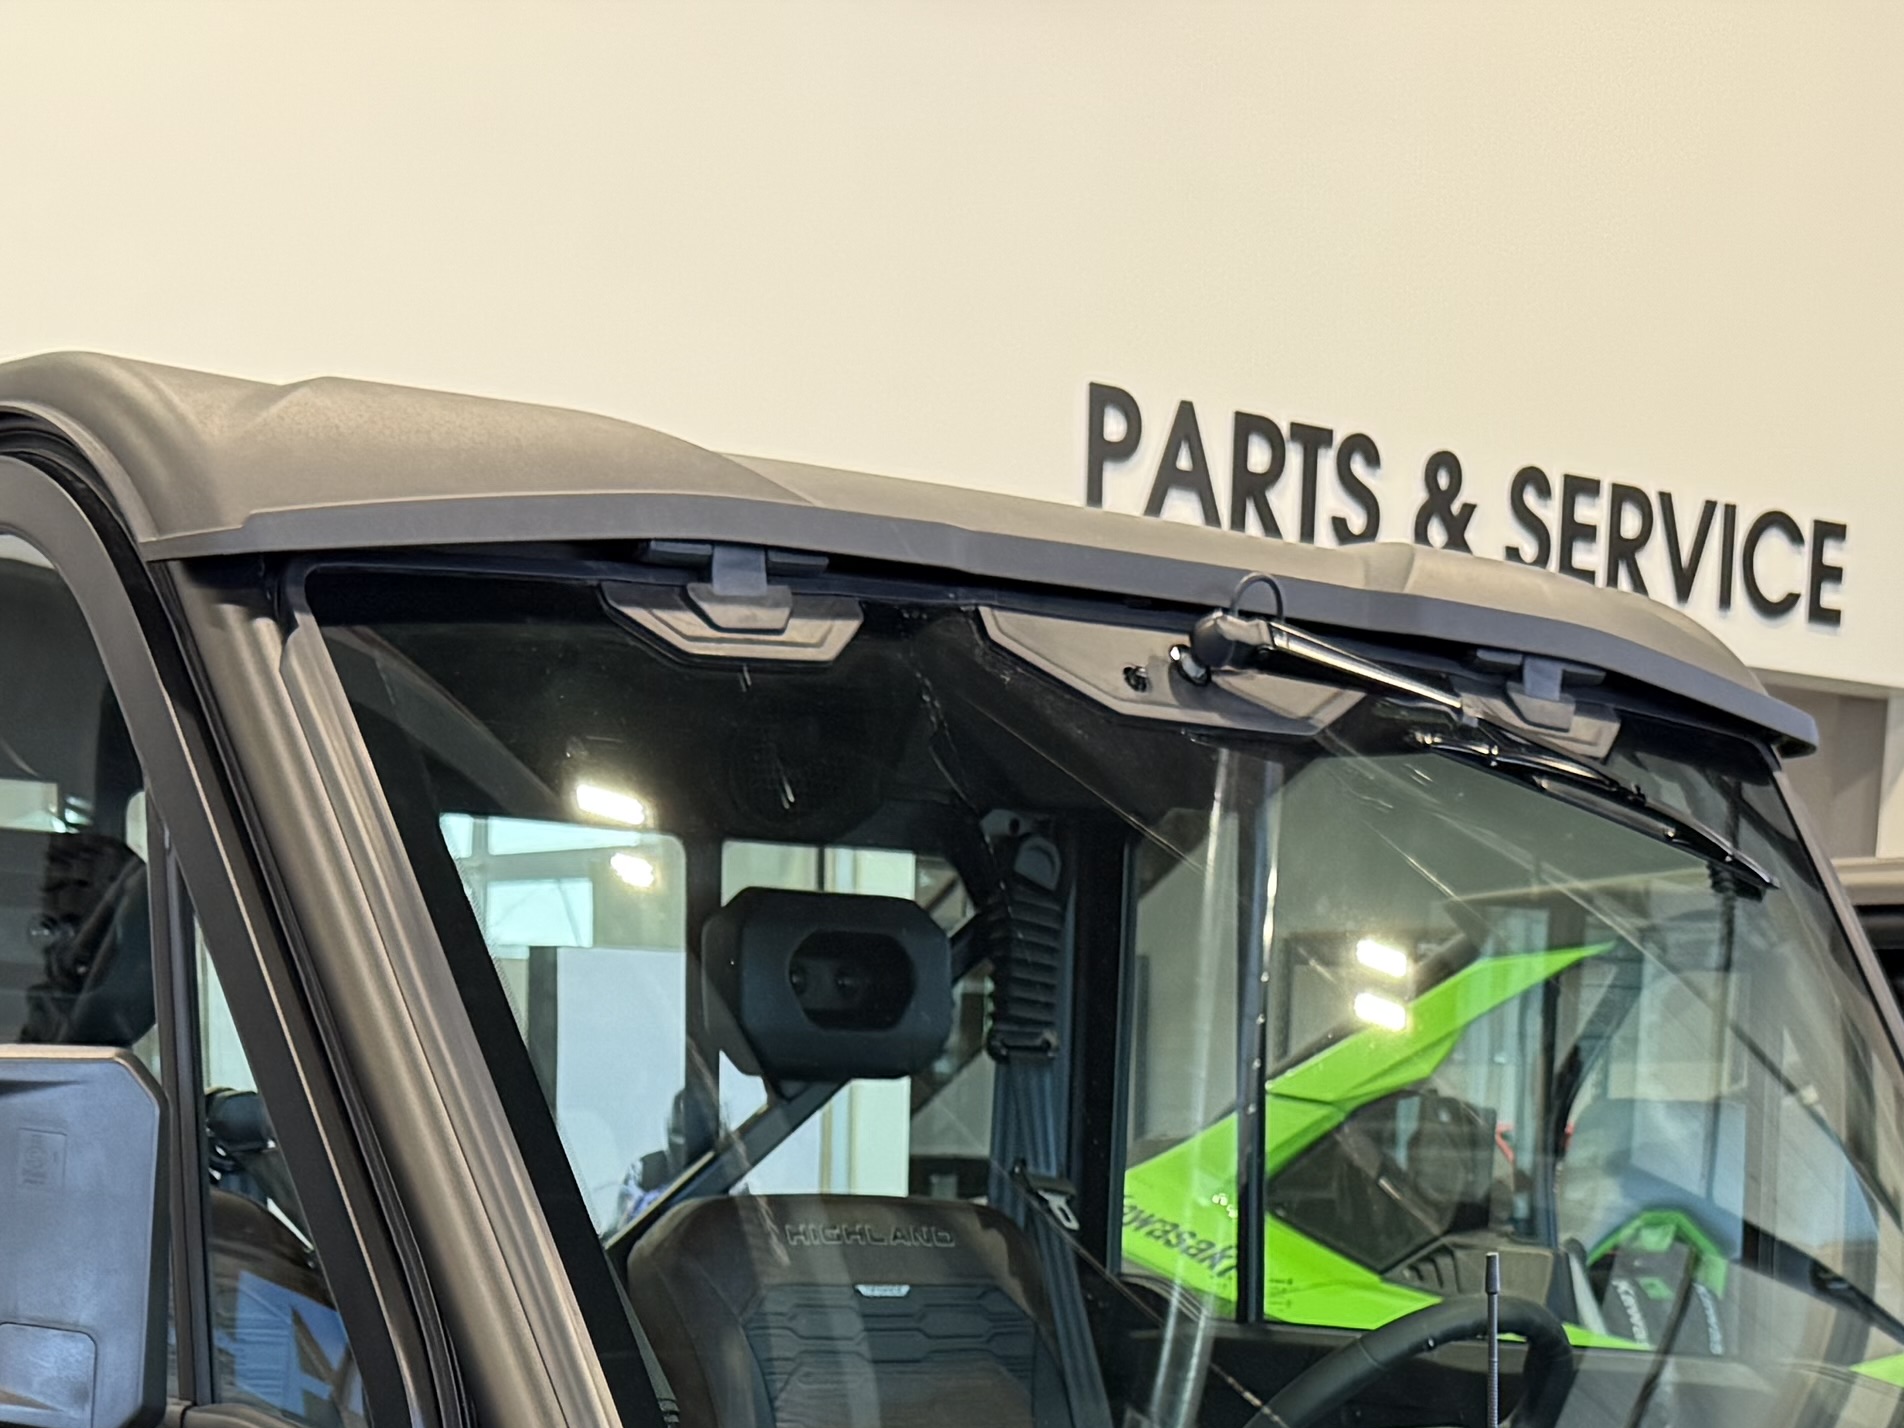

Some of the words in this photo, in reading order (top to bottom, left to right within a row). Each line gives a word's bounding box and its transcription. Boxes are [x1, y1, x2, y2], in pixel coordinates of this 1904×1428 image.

[1087, 381, 1381, 547] PARTS
[1414, 450, 1478, 554] &
[1505, 466, 1847, 627] SERVICE
[785, 1224, 955, 1248] HIGHLAND
[1123, 1203, 1237, 1278] awasaki
